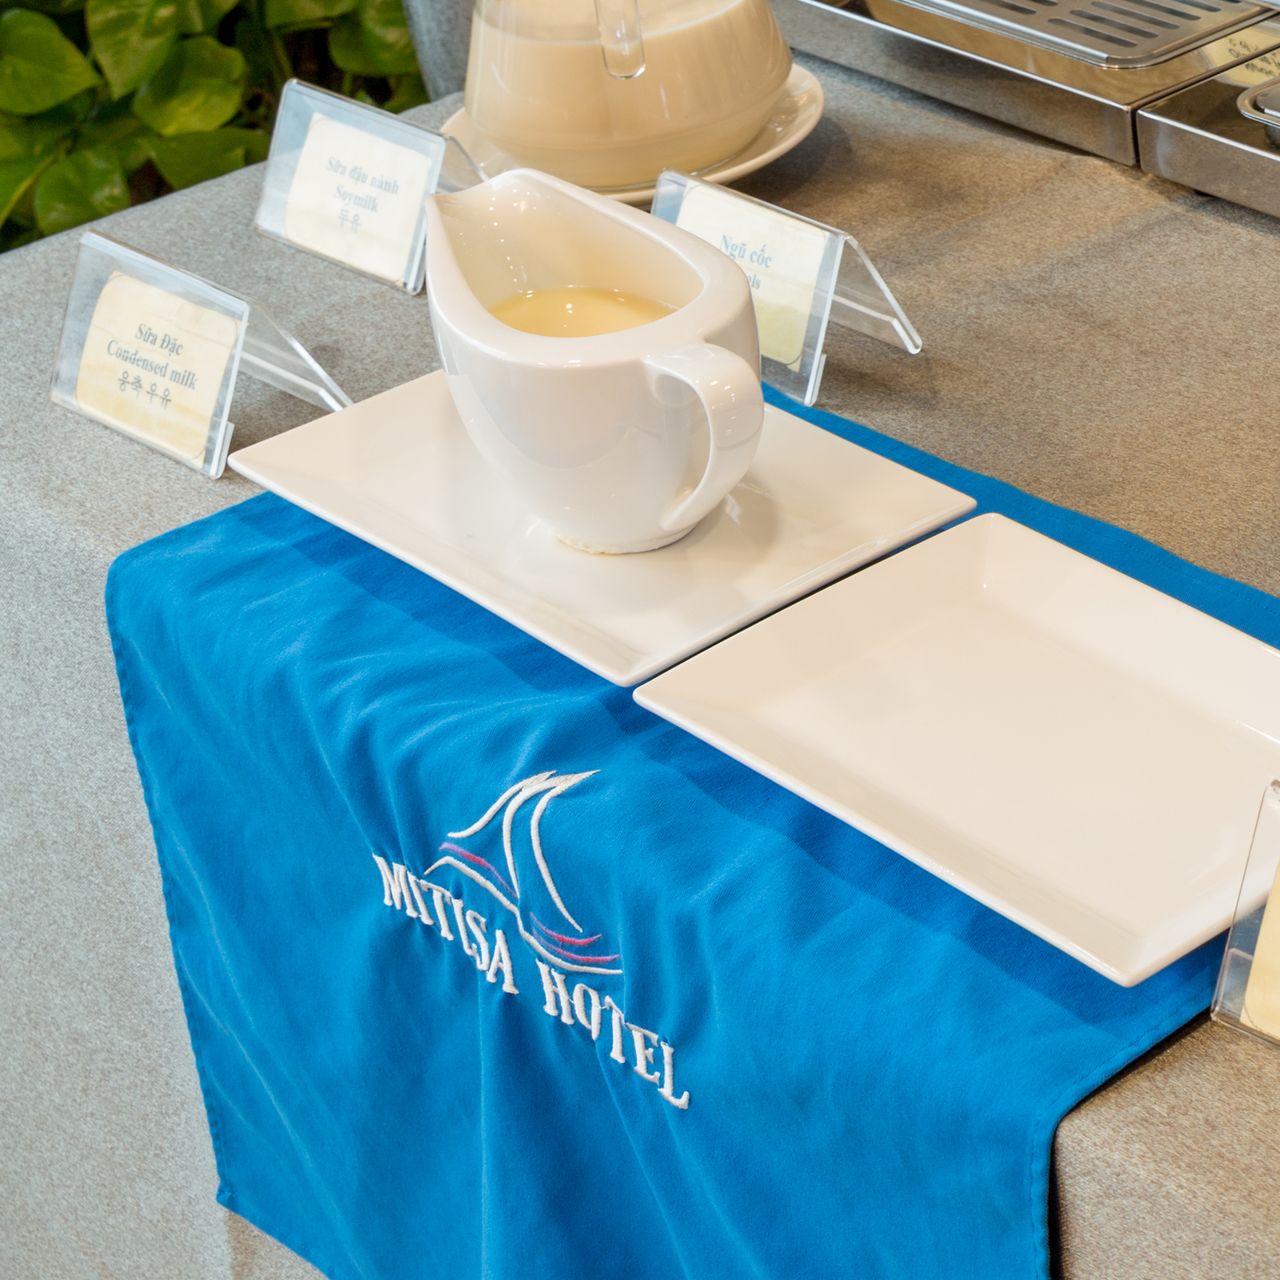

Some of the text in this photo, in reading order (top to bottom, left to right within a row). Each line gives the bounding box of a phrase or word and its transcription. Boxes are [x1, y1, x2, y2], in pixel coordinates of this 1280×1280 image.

[749, 244, 773, 268] cốc
[134, 323, 184, 357] Sữa Đặc
[106, 339, 198, 391] Condensed milk
[146, 383, 172, 409] 우유
[372, 853, 691, 1110] MITISA HOTEL
